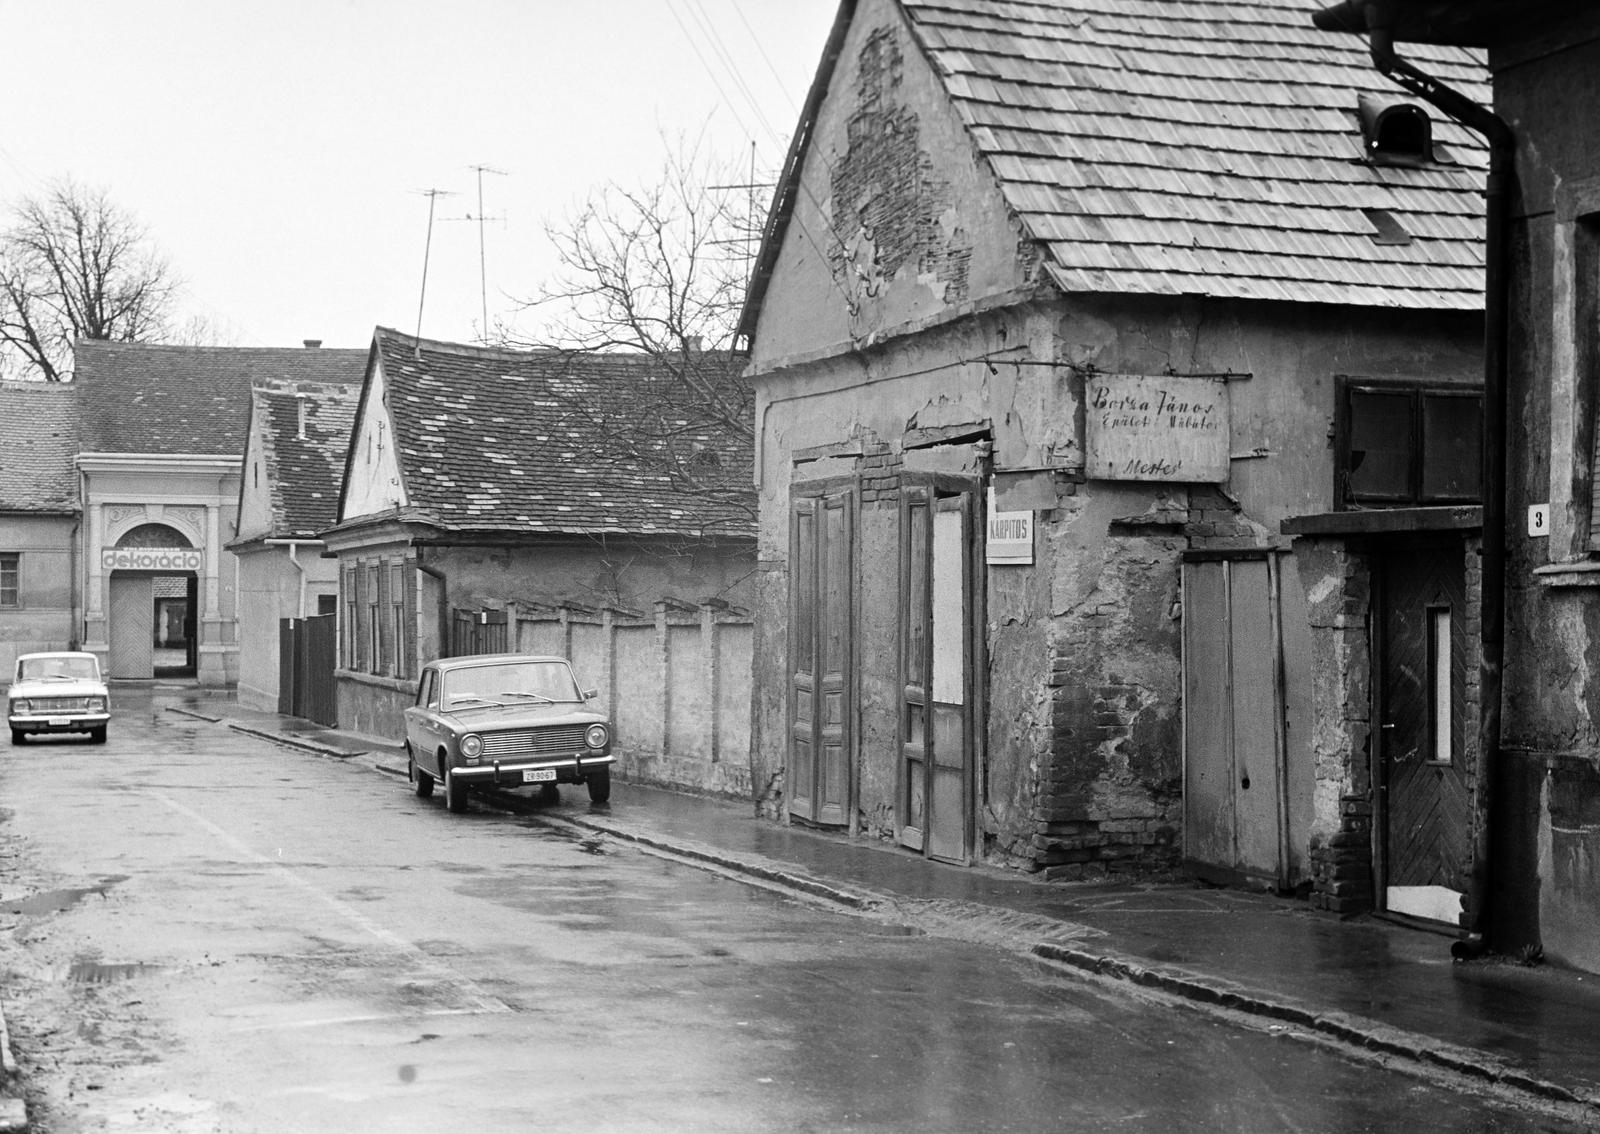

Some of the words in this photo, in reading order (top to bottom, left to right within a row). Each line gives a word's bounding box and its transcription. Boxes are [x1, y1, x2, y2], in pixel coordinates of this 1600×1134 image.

[1157, 390, 1214, 415] János
[1535, 511, 1543, 528] 3
[103, 551, 200, 568] dekoráció
